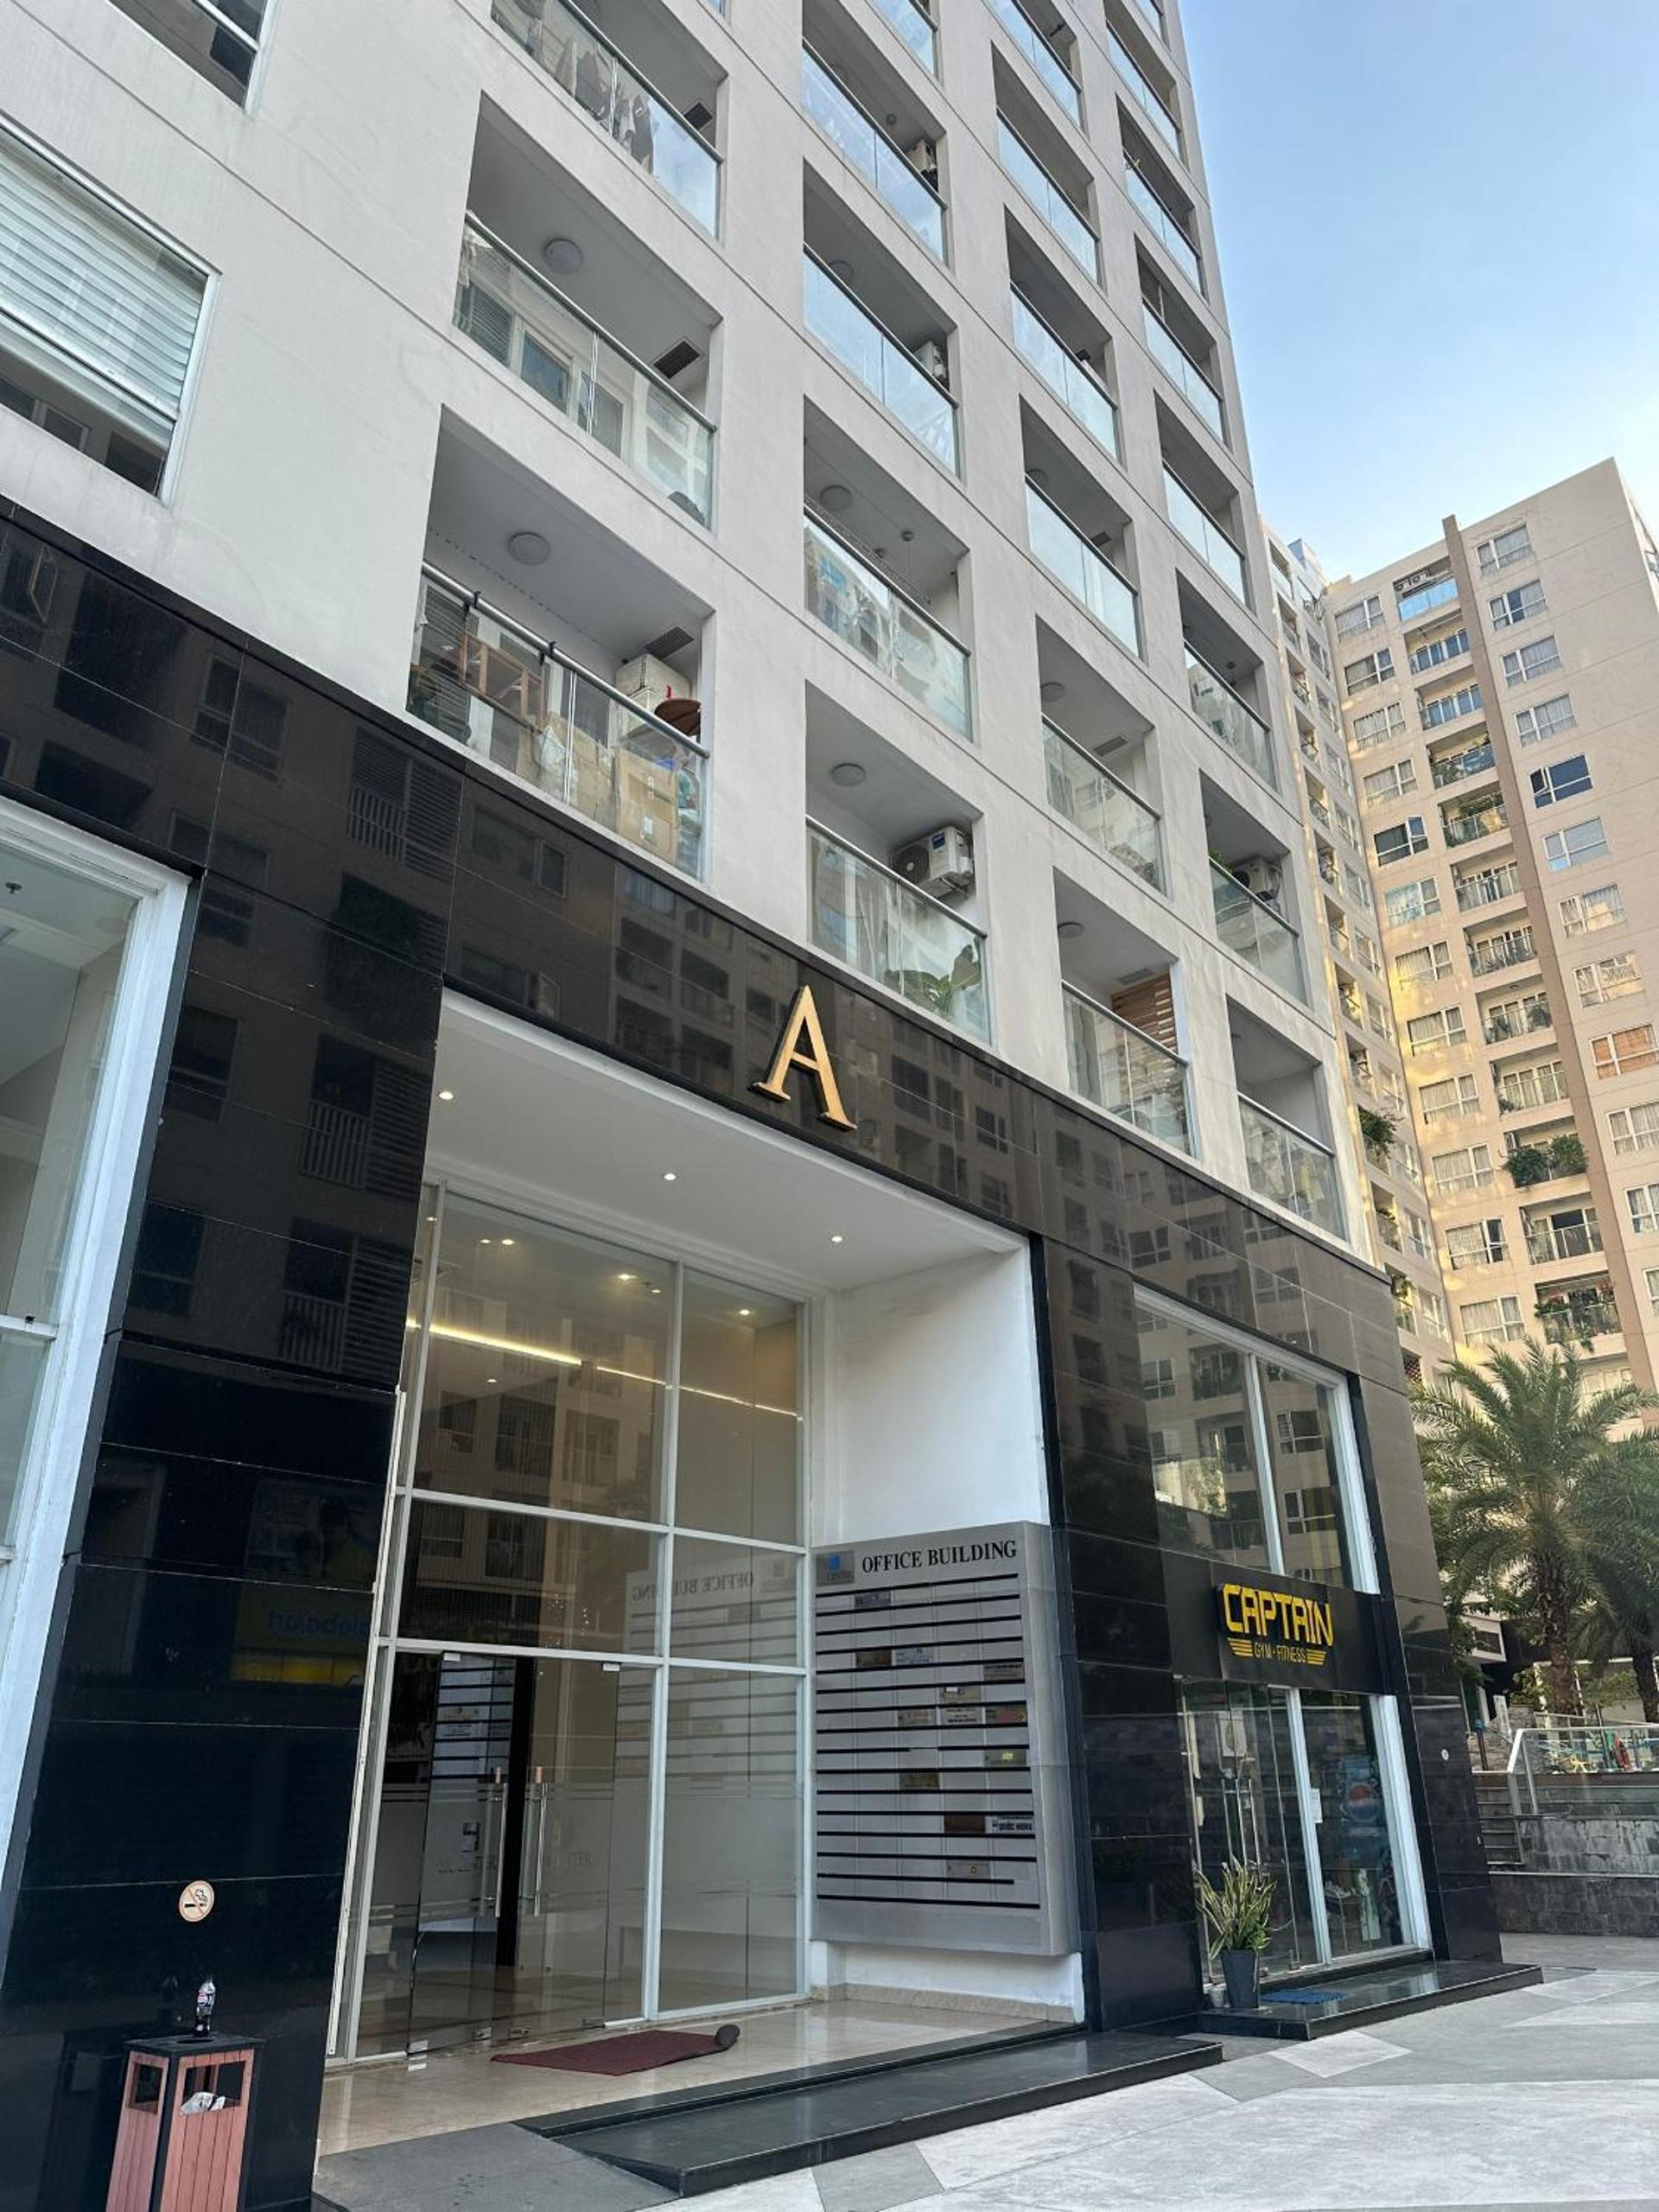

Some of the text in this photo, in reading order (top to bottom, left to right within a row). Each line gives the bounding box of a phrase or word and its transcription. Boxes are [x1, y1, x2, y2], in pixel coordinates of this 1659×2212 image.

[752, 985, 857, 1131] A
[861, 1540, 1017, 1573] OFFICE BUILDING
[1223, 1584, 1334, 1646] CAPTAIN
